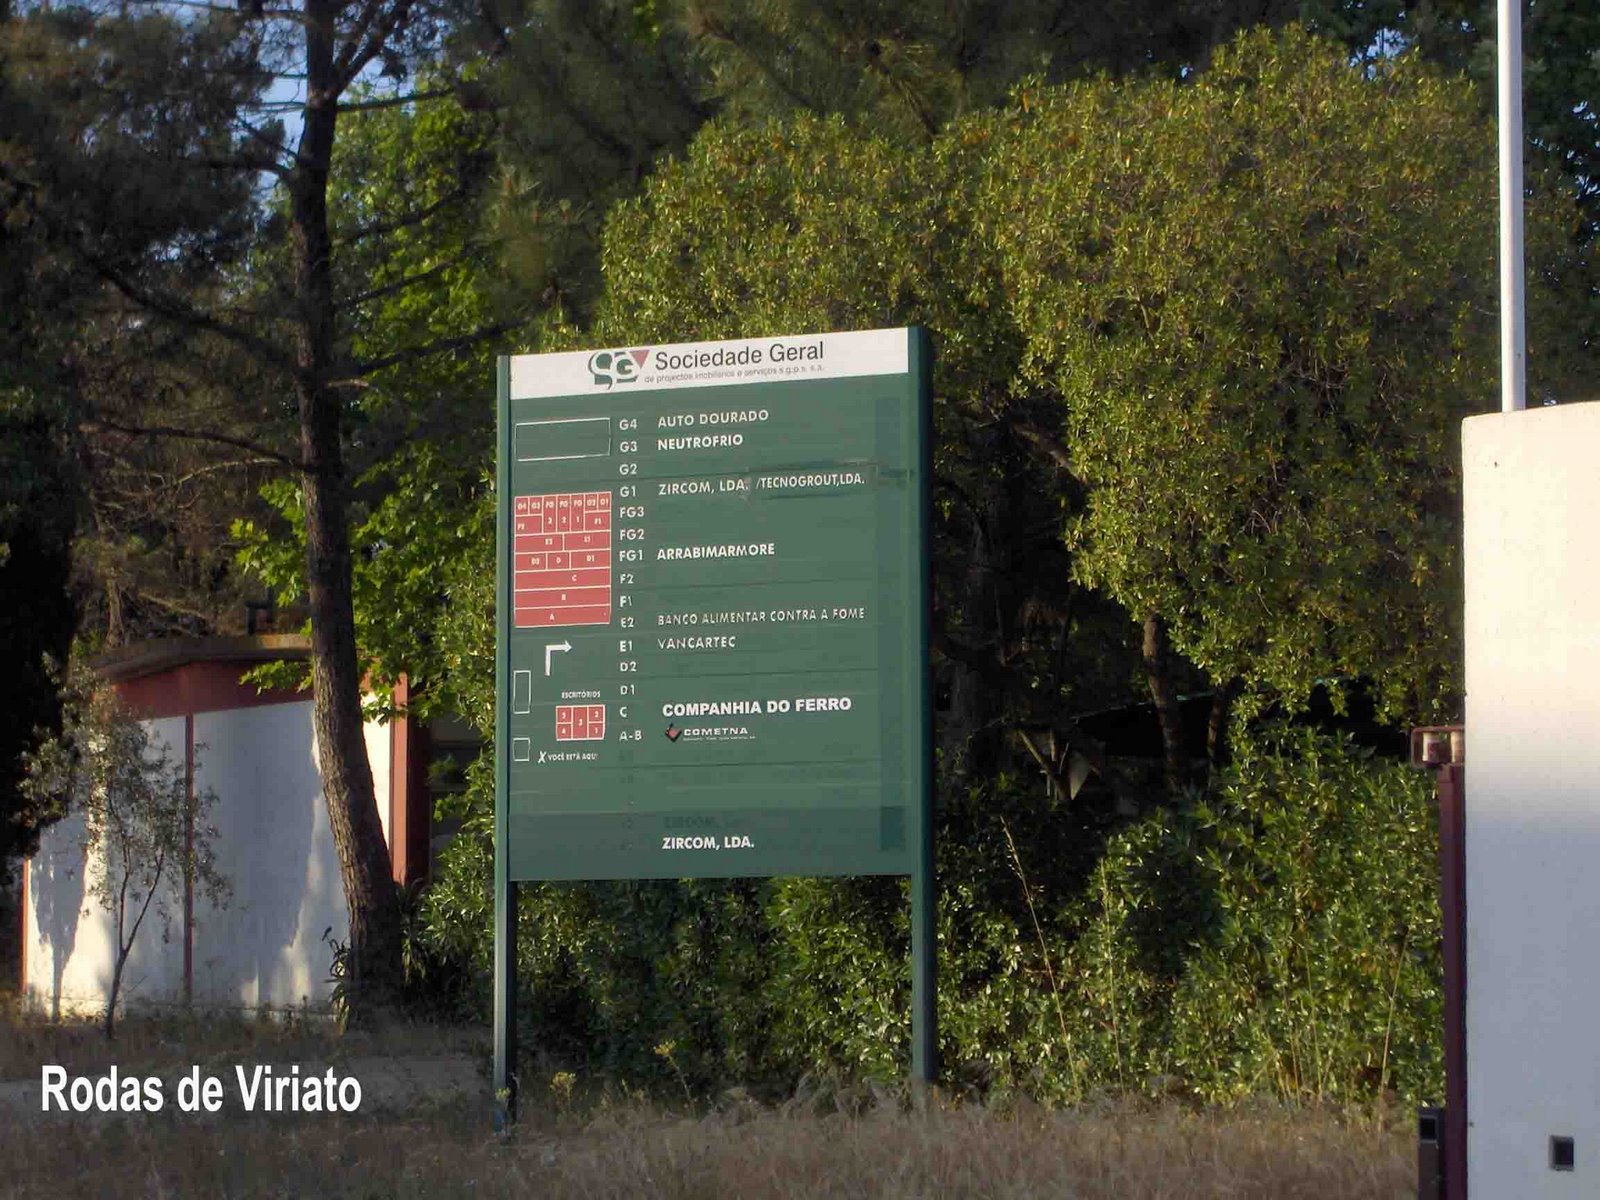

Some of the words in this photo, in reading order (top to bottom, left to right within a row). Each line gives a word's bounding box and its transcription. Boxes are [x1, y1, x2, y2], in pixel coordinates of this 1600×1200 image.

[655, 345, 762, 371] Sociedade
[769, 341, 824, 361] Geral
[644, 375, 654, 383] de
[619, 419, 637, 430] G4
[658, 414, 694, 428] AUTO
[700, 410, 769, 425] DOURADO
[620, 442, 637, 452] G3
[657, 434, 743, 450] NEUTROFRIO
[620, 463, 637, 475] G2
[620, 486, 636, 497] G1
[658, 481, 714, 495] ZIRCOM,
[720, 479, 748, 492] LDA.
[620, 507, 644, 518] FG3
[620, 529, 644, 540] FG2
[619, 550, 643, 561] FG1
[657, 543, 775, 560] ARRABIMARMORE
[620, 574, 634, 584] F2
[620, 596, 632, 607] F1
[658, 614, 697, 626] BANCO
[702, 611, 766, 624] ALIMENTAR
[770, 608, 816, 622] CONTRA
[821, 608, 828, 620] A
[833, 607, 865, 619] FOME
[621, 617, 634, 628] E2
[620, 640, 632, 652] E1
[658, 636, 736, 650] VANCARTEC
[620, 661, 636, 672] D2
[621, 684, 635, 695] D1
[619, 707, 627, 718] C
[662, 700, 762, 717] COMPANHIA
[767, 699, 790, 713] DO
[795, 697, 851, 712] FERRO
[619, 730, 642, 741] A-B
[684, 727, 748, 736] COMETNA
[662, 836, 720, 850] ZIRCOM,
[724, 836, 755, 848] LDA.
